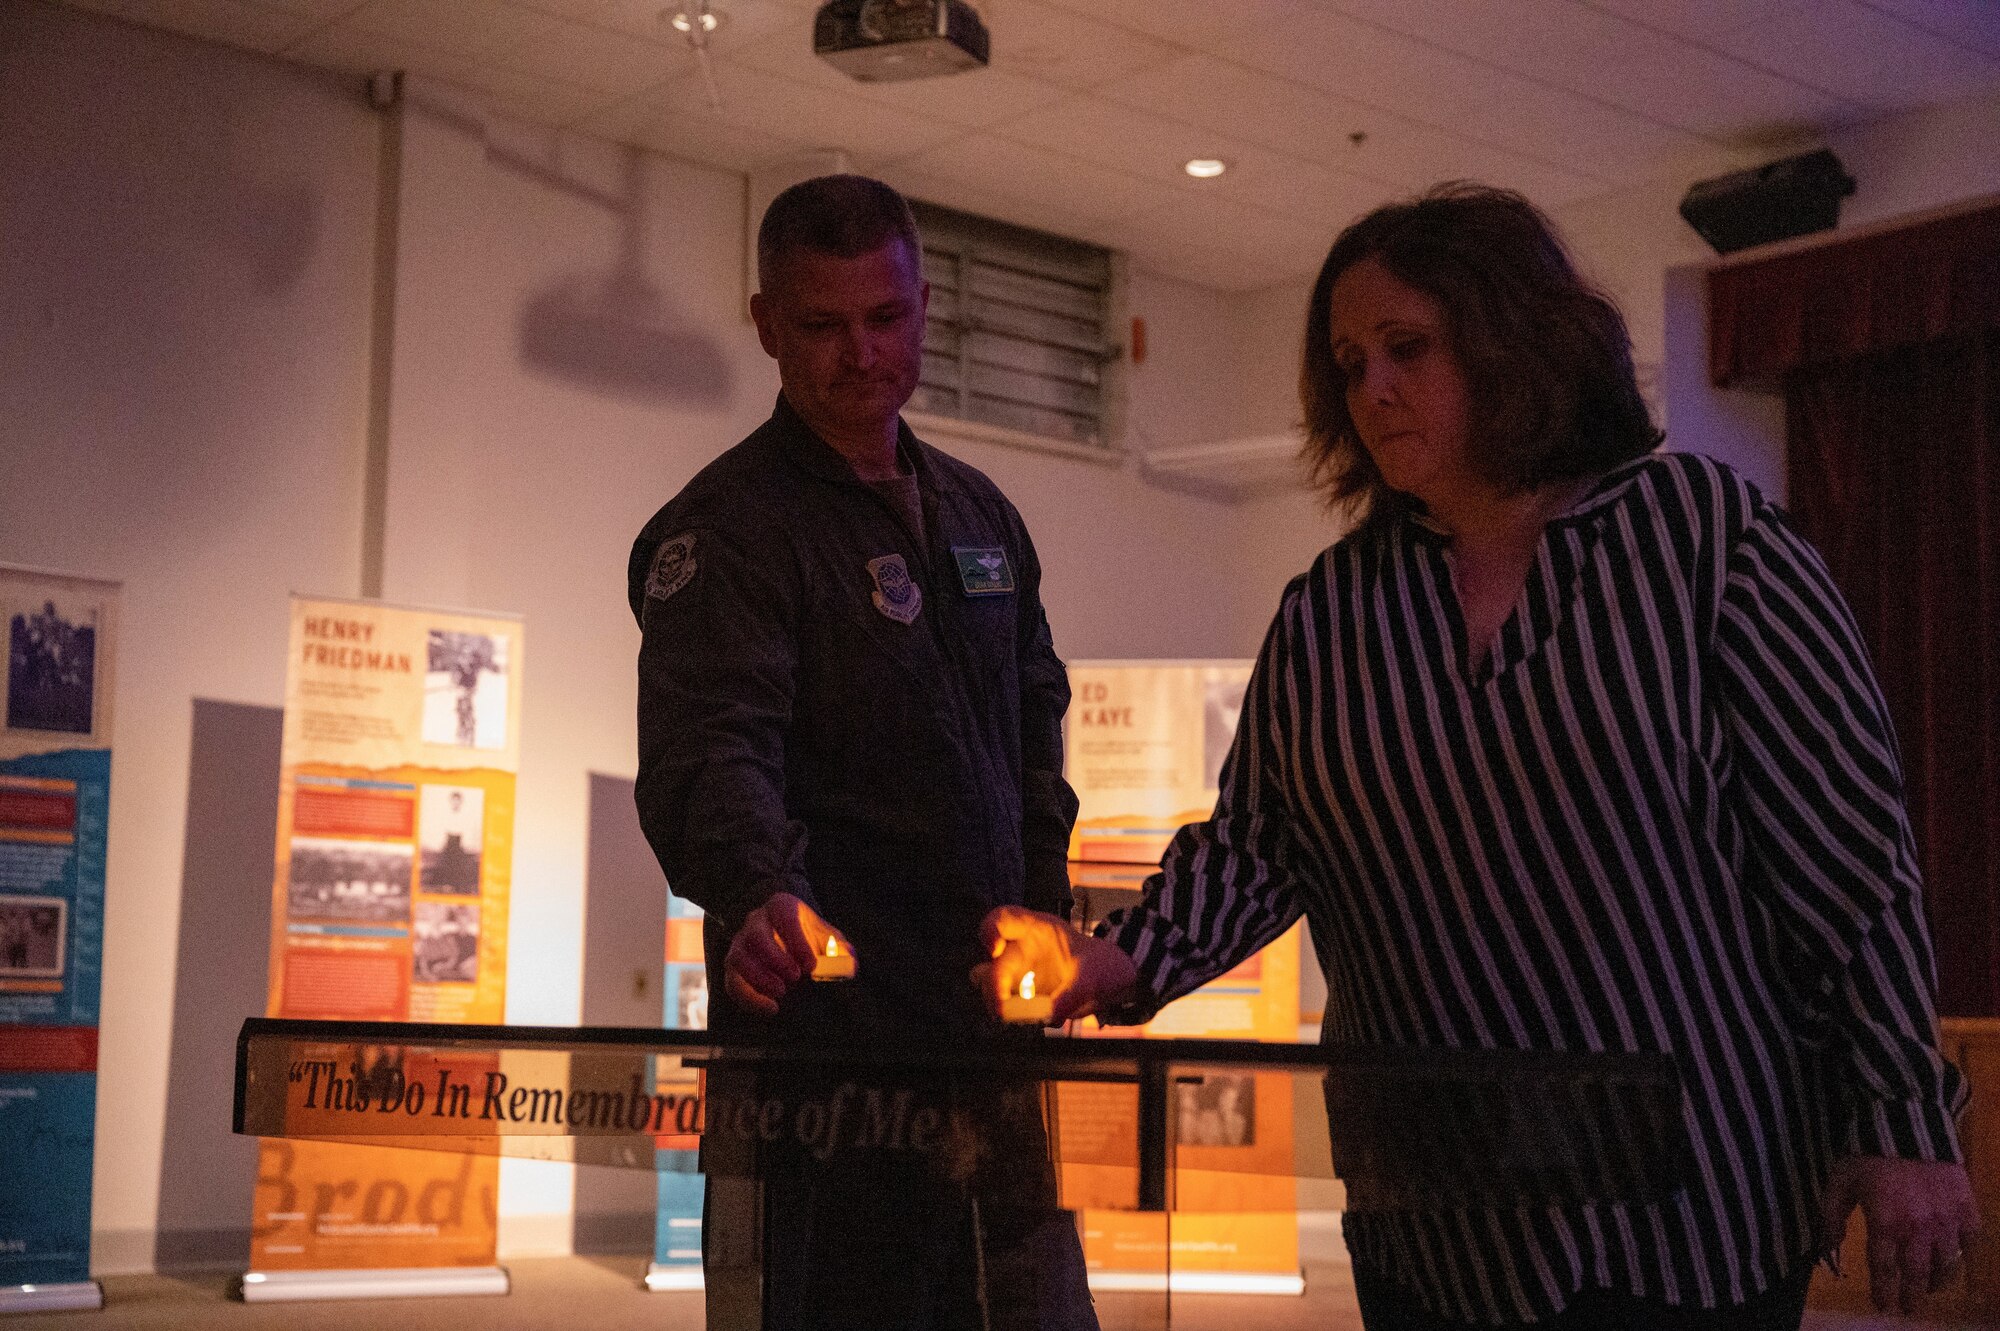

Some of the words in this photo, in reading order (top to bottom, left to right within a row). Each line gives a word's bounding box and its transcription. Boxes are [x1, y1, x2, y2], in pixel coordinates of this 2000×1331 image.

[304, 615, 375, 642] HENRY
[302, 642, 413, 674] FRIEDMAN
[1081, 681, 1108, 703] ED
[1081, 706, 1134, 728] KAYE
[376, 1066, 425, 1116] Do
[431, 1069, 472, 1119] In
[479, 1072, 784, 1142] Remembrance
[795, 1081, 858, 1161] of
